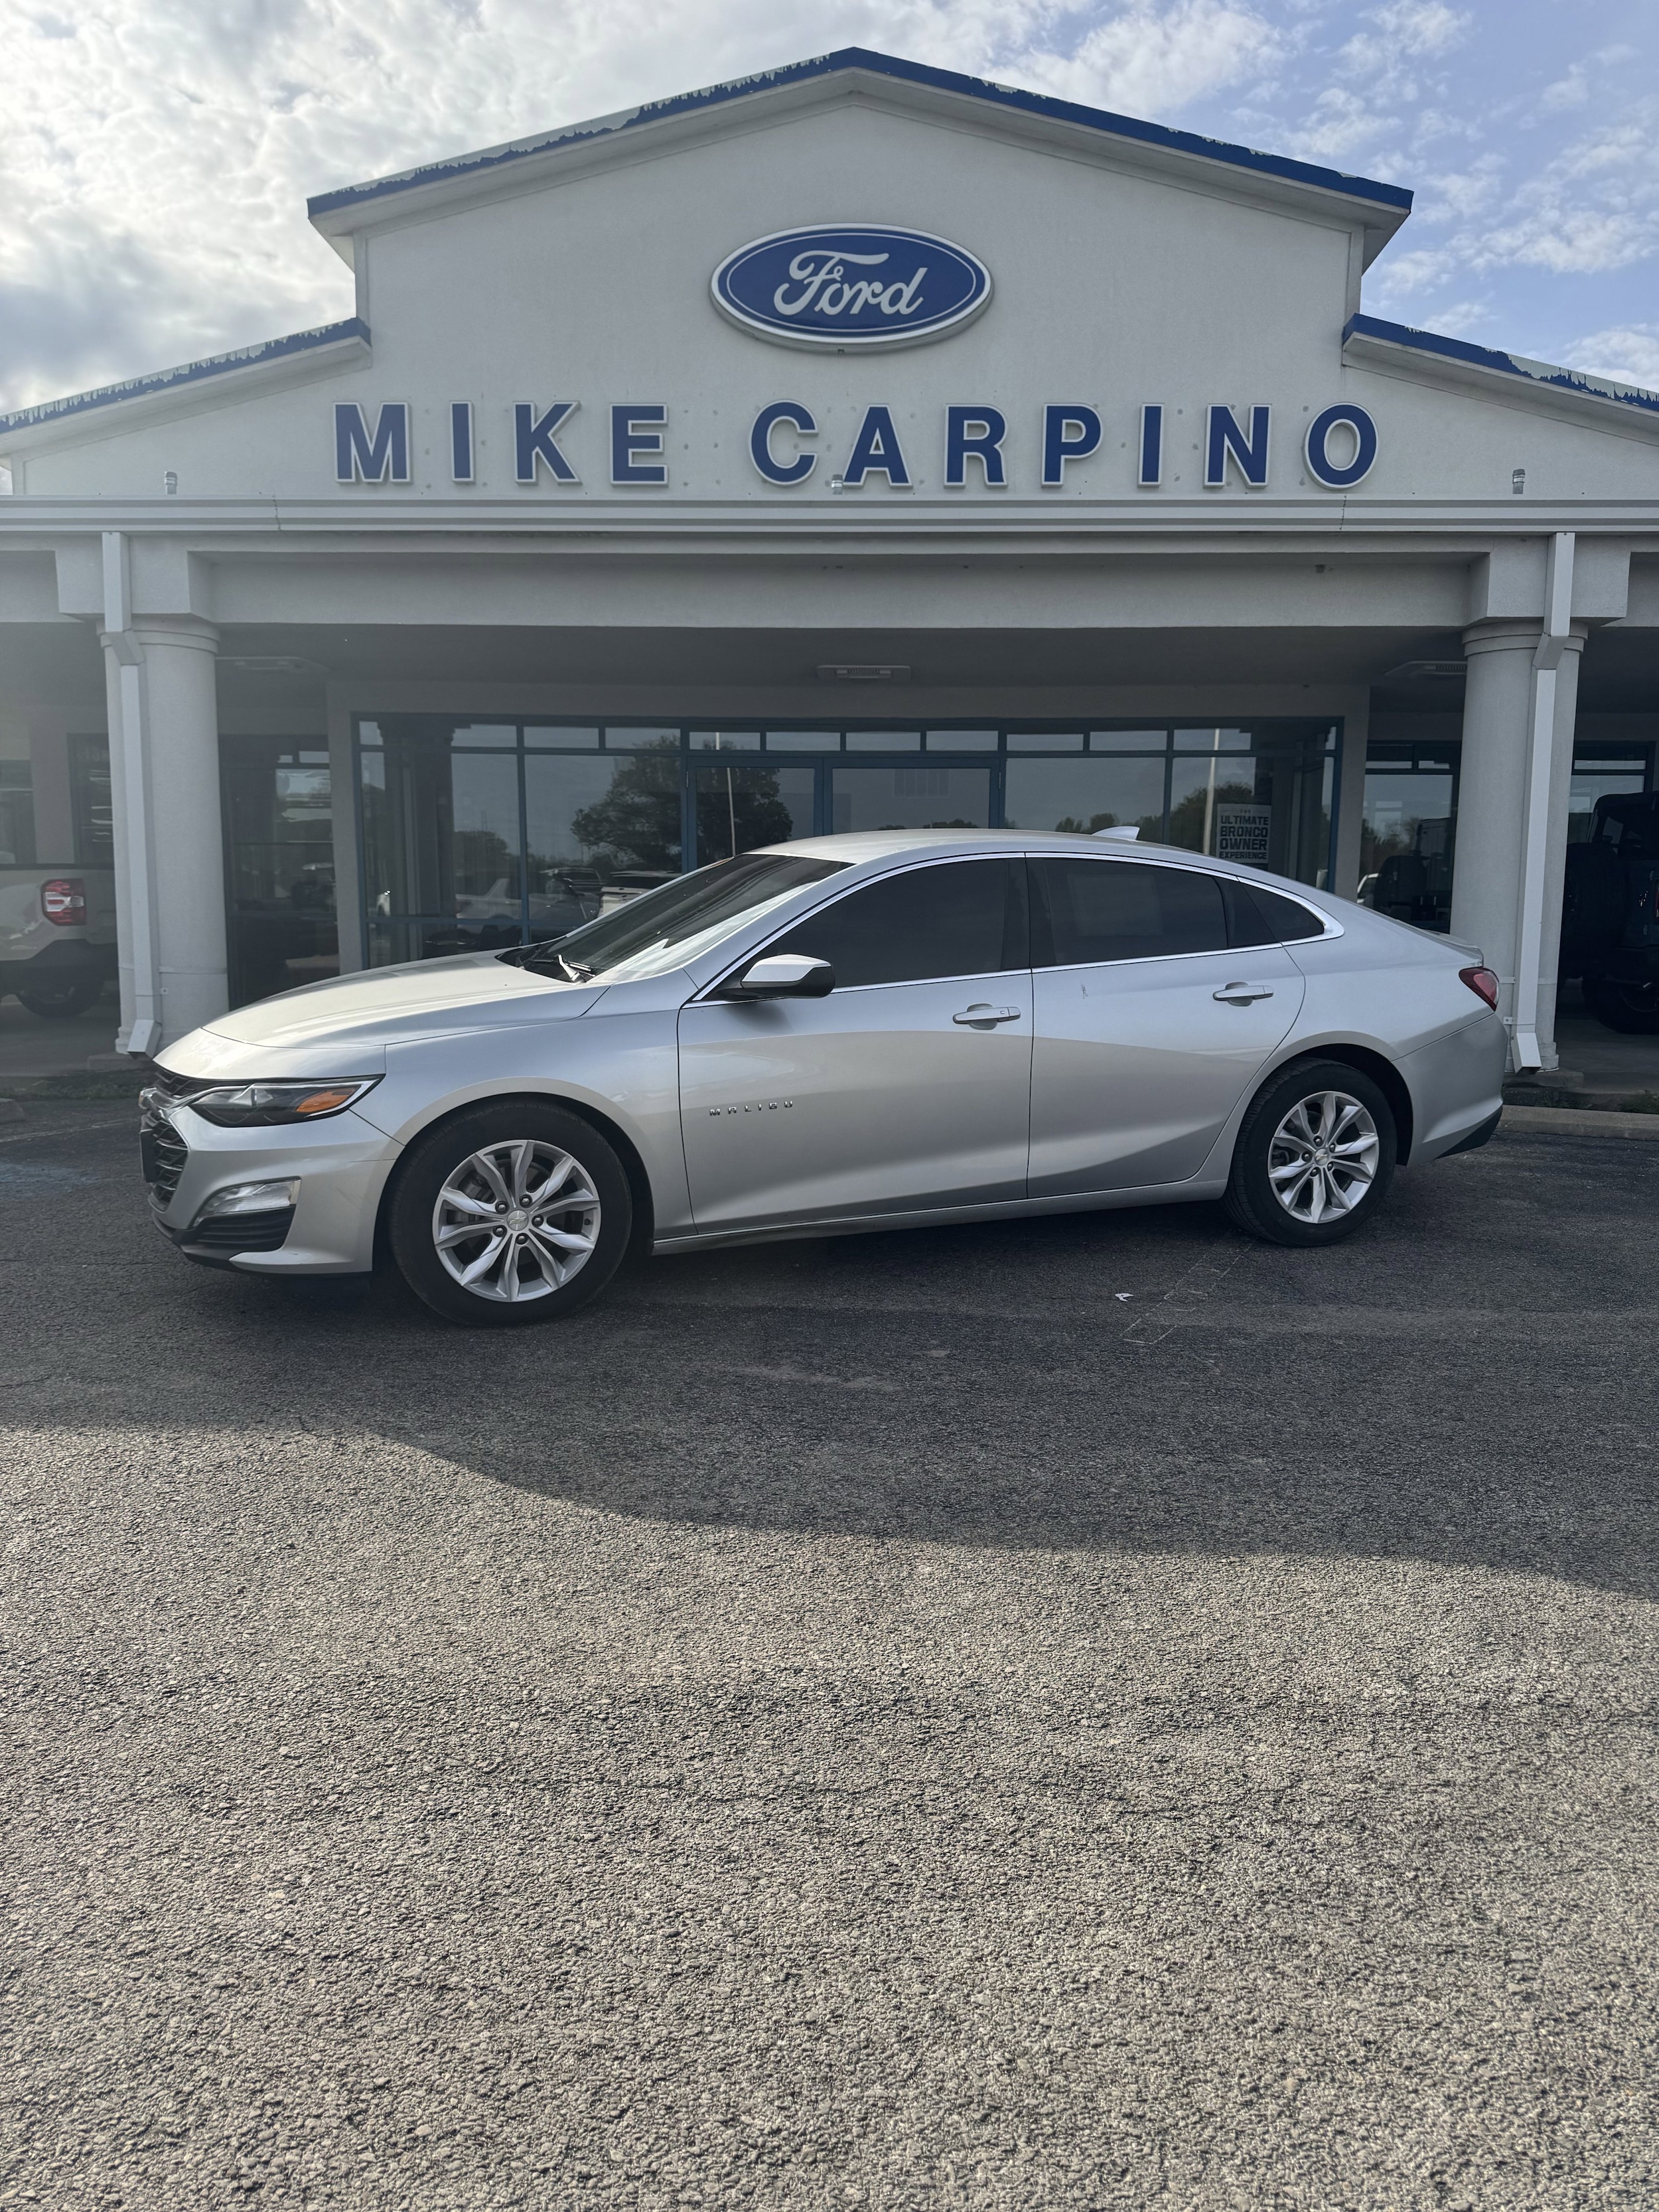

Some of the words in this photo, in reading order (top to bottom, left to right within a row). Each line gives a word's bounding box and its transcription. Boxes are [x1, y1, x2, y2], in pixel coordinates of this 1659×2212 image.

[774, 250, 928, 315] Ford
[333, 400, 669, 487] MIKE
[749, 400, 1380, 490] CARPINO
[1220, 815, 1269, 826] ULTIMATE
[1220, 826, 1268, 838] BRONCO
[1220, 838, 1267, 850] OWNER
[1219, 851, 1267, 859] EXPERIENCE
[709, 1100, 793, 1116] MALIBU
